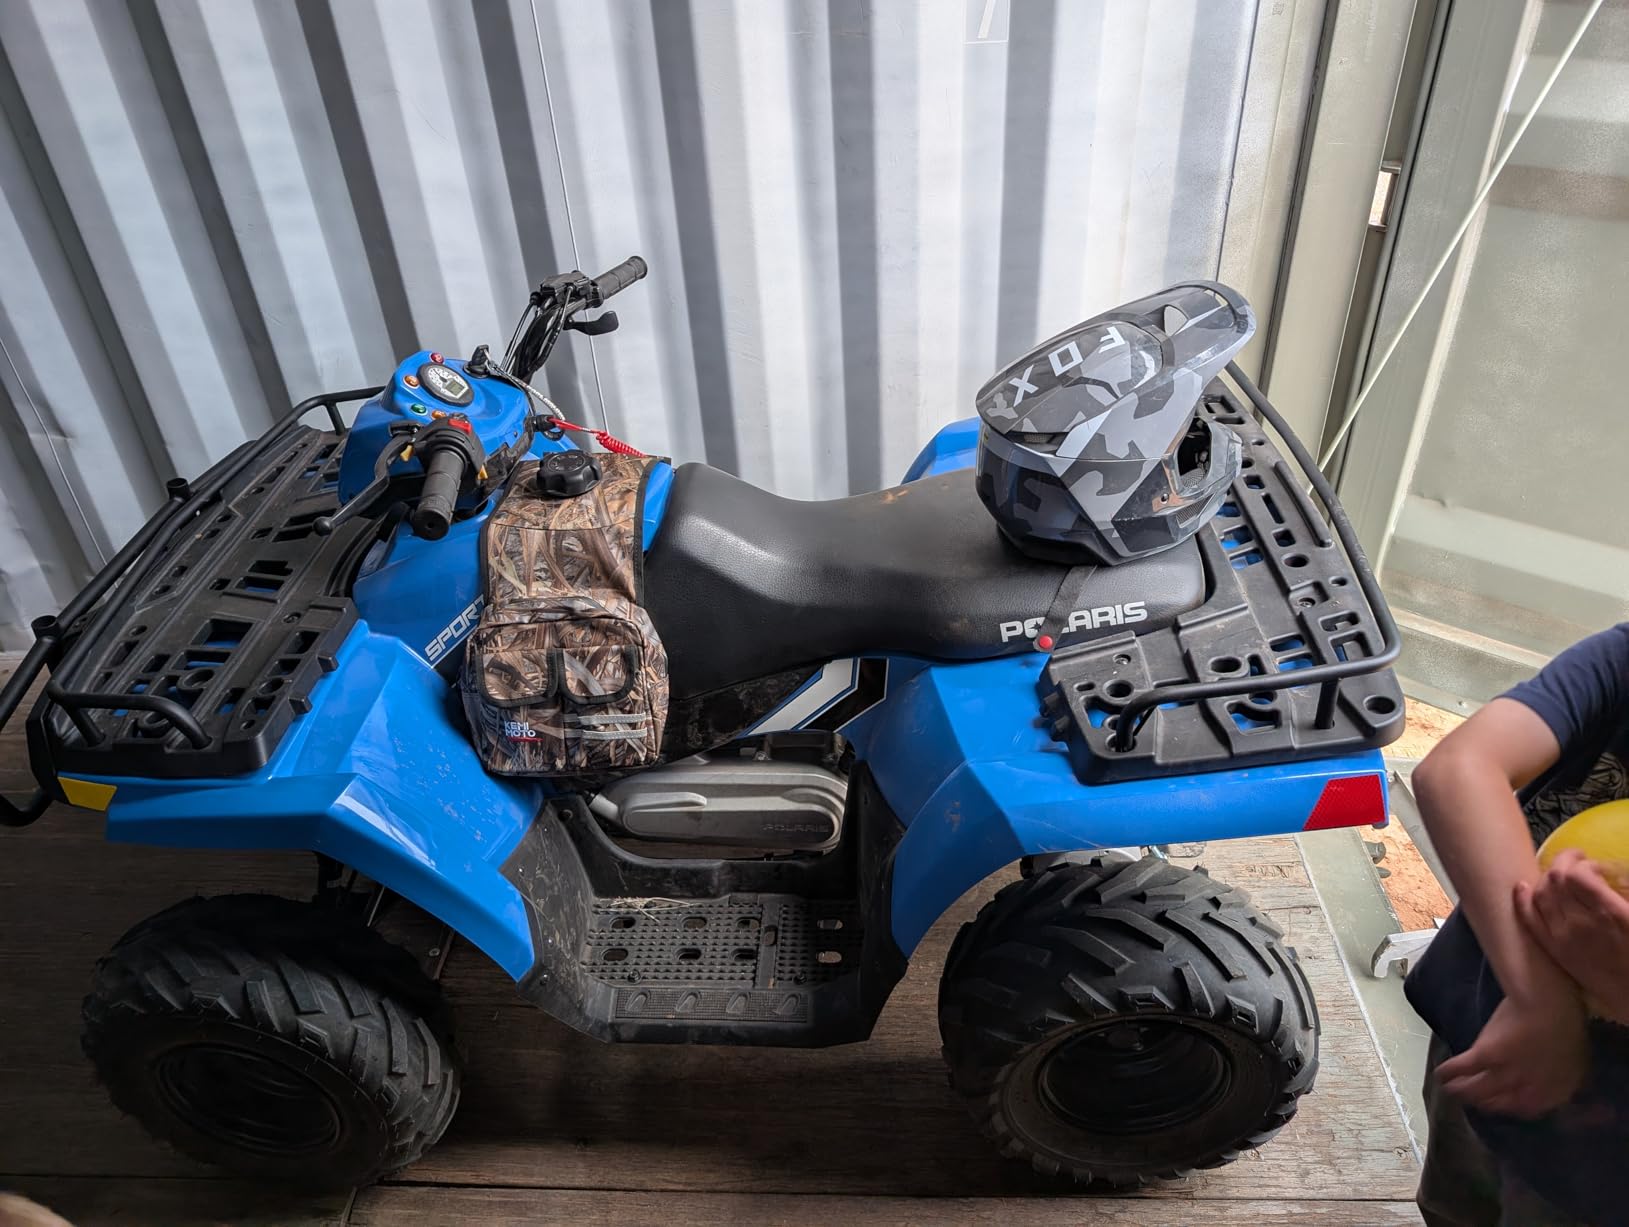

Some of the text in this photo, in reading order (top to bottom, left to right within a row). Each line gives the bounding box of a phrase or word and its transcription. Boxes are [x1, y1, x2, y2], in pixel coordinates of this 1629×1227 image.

[1008, 326, 1126, 407] FOX
[1000, 601, 1148, 643] POARIS
[504, 721, 530, 730] KEMI
[505, 730, 537, 738] MOTO
